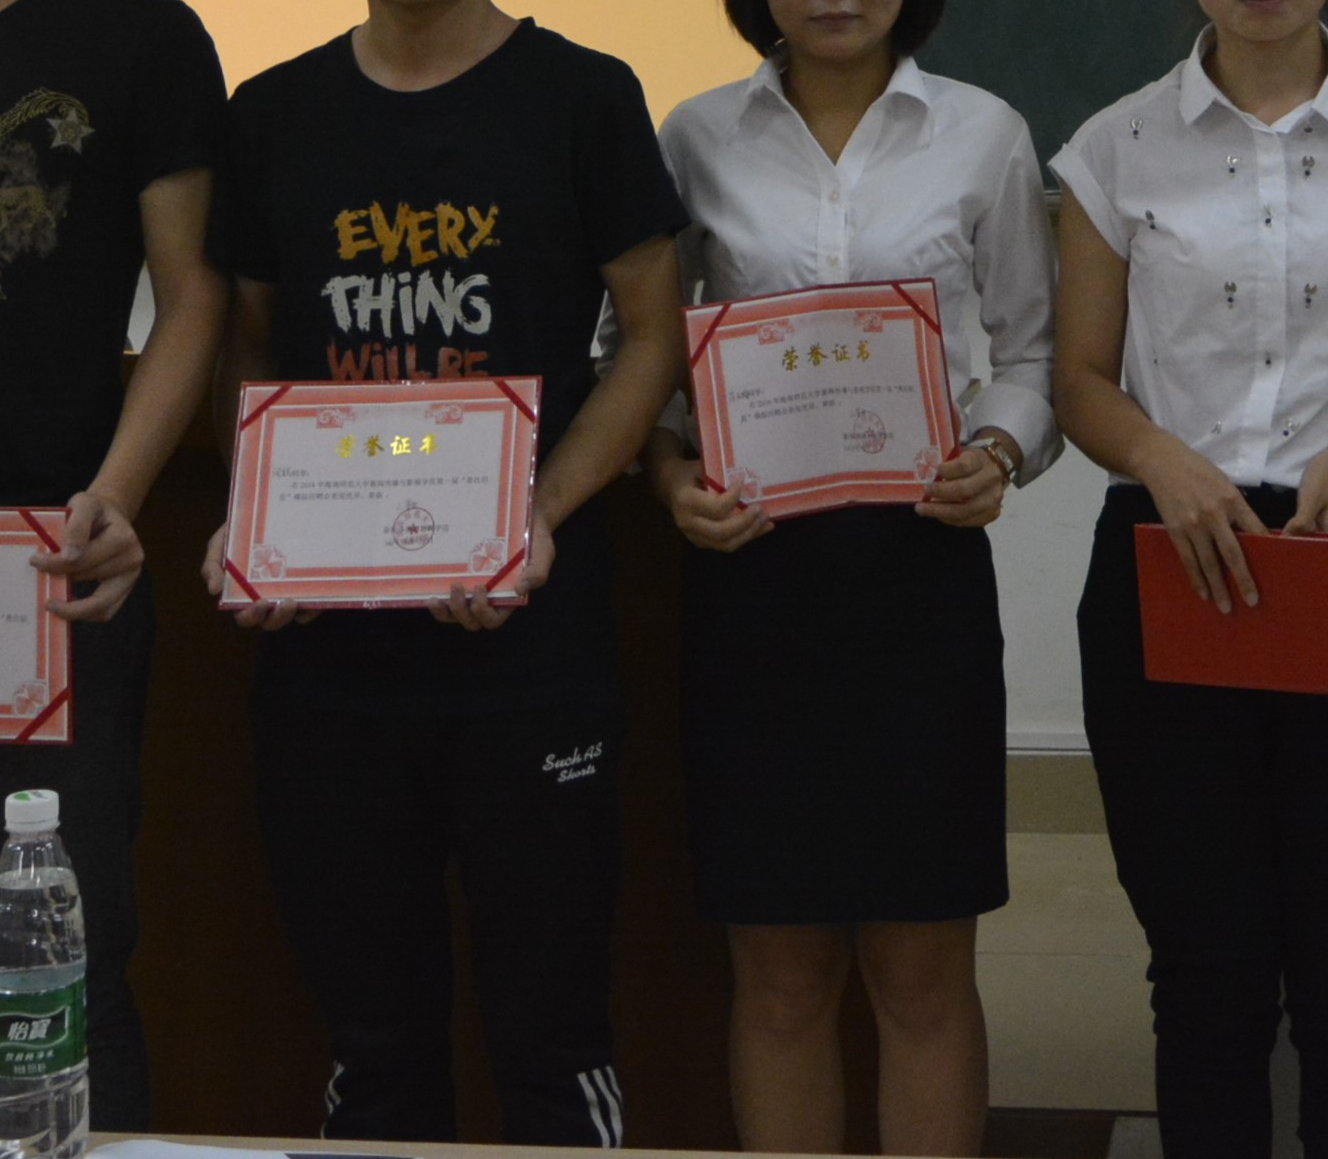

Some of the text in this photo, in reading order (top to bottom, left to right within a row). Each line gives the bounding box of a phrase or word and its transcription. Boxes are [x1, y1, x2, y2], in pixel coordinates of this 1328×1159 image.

[332, 201, 499, 266] EVERY
[782, 340, 871, 372] 荣誉证书
[542, 746, 582, 771] Such
